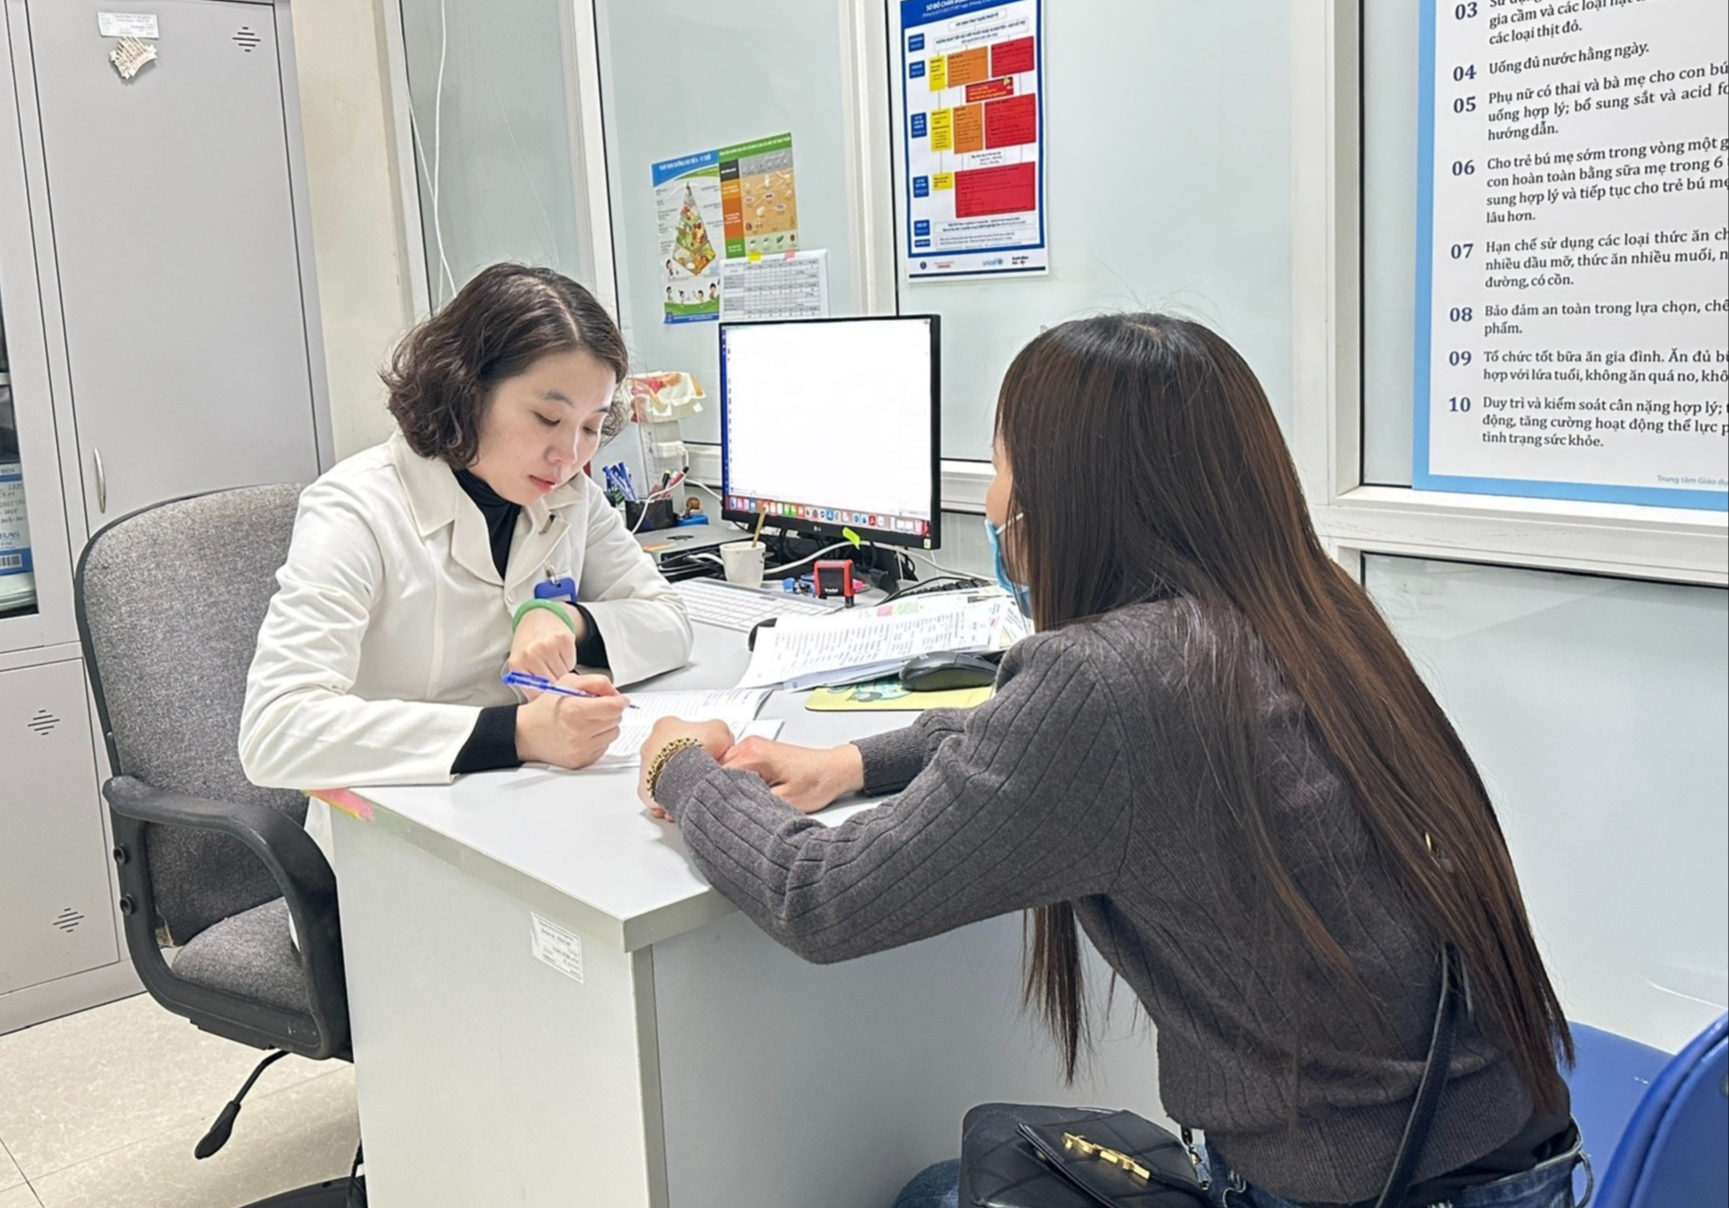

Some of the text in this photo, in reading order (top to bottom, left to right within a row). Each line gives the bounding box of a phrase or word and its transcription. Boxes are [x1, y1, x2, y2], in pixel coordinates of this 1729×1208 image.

[1455, 2, 1478, 20] 03
[1489, 14, 1507, 29] gia
[1511, 9, 1536, 22] cầm
[1540, 4, 1554, 17] và
[1558, 1, 1579, 14] các
[1489, 20, 1582, 44] các loại thịt đỏ.
[1453, 42, 1649, 81] 04 Uống đủ nước hằng ngày.
[1454, 61, 1728, 113] 05 Phụ nữ có thai và bà mẹ cho con bú
[1488, 108, 1520, 122] uống
[1524, 106, 1549, 119] hợp
[1554, 102, 1569, 117] lý;
[1575, 97, 1591, 112] bổ
[1596, 98, 1629, 110] sung
[1634, 90, 1655, 105] sắt
[1660, 89, 1675, 101] và
[1681, 83, 1711, 99] acid
[1488, 121, 1558, 140] hướng dẫn.
[1452, 136, 1717, 176] 06 Cho trẻ bú mẹ sớm trong vòng một
[1487, 156, 1723, 187] con hoàn toàn bằng sữa mẹ trong 6
[1487, 195, 1516, 207] sung
[1520, 192, 1544, 205] hợp
[1548, 188, 1559, 204] lý
[1562, 187, 1576, 200] và
[1580, 184, 1605, 200] tiếp
[1610, 185, 1631, 198] tục
[1634, 182, 1658, 194] cho
[1663, 179, 1682, 192] trẻ
[1687, 177, 1704, 190] bú
[1487, 211, 1535, 223] lâu hơn.
[1451, 243, 1473, 259] 07
[1486, 241, 1510, 254] Hạn
[1515, 237, 1537, 250] chế
[1540, 237, 1557, 250] sử
[1560, 237, 1594, 250] dụng
[1598, 234, 1620, 247] các
[1625, 233, 1649, 247] loại
[1655, 230, 1687, 244] thức
[1691, 229, 1709, 242] ăn
[1486, 248, 1715, 270] nhiều dầu mỡ, thức ăn nhiều muối,
[1485, 273, 1574, 289] đường, có cồn.
[1450, 307, 1472, 322] 08
[1485, 305, 1508, 316] Bảo
[1512, 304, 1538, 315] đảm
[1543, 306, 1558, 315] an
[1562, 303, 1590, 314] toàn
[1595, 304, 1631, 316] trong
[1636, 301, 1657, 316] lựa
[1662, 300, 1700, 315] chọn,
[1485, 321, 1522, 337] phẩm.
[1449, 348, 1710, 366] 09 Tổ chức tốt bữa ăn gia đình. Ăn đủ
[1484, 369, 1508, 382] hợp
[1510, 369, 1529, 380] với
[1532, 369, 1552, 380] lứa
[1555, 368, 1583, 382] tuổi,
[1586, 369, 1627, 384] không
[1629, 370, 1645, 381] ăn
[1649, 370, 1674, 384] quá
[1678, 372, 1699, 383] no,
[1449, 396, 1722, 416] 10 Duy trì và kiểm soát cân nặng hợp lý;
[1483, 414, 1717, 435] động, tăng cường hoạt động thể lực
[1483, 432, 1604, 447] tình trạng sức khỏe.
[1657, 475, 1679, 484] Trung
